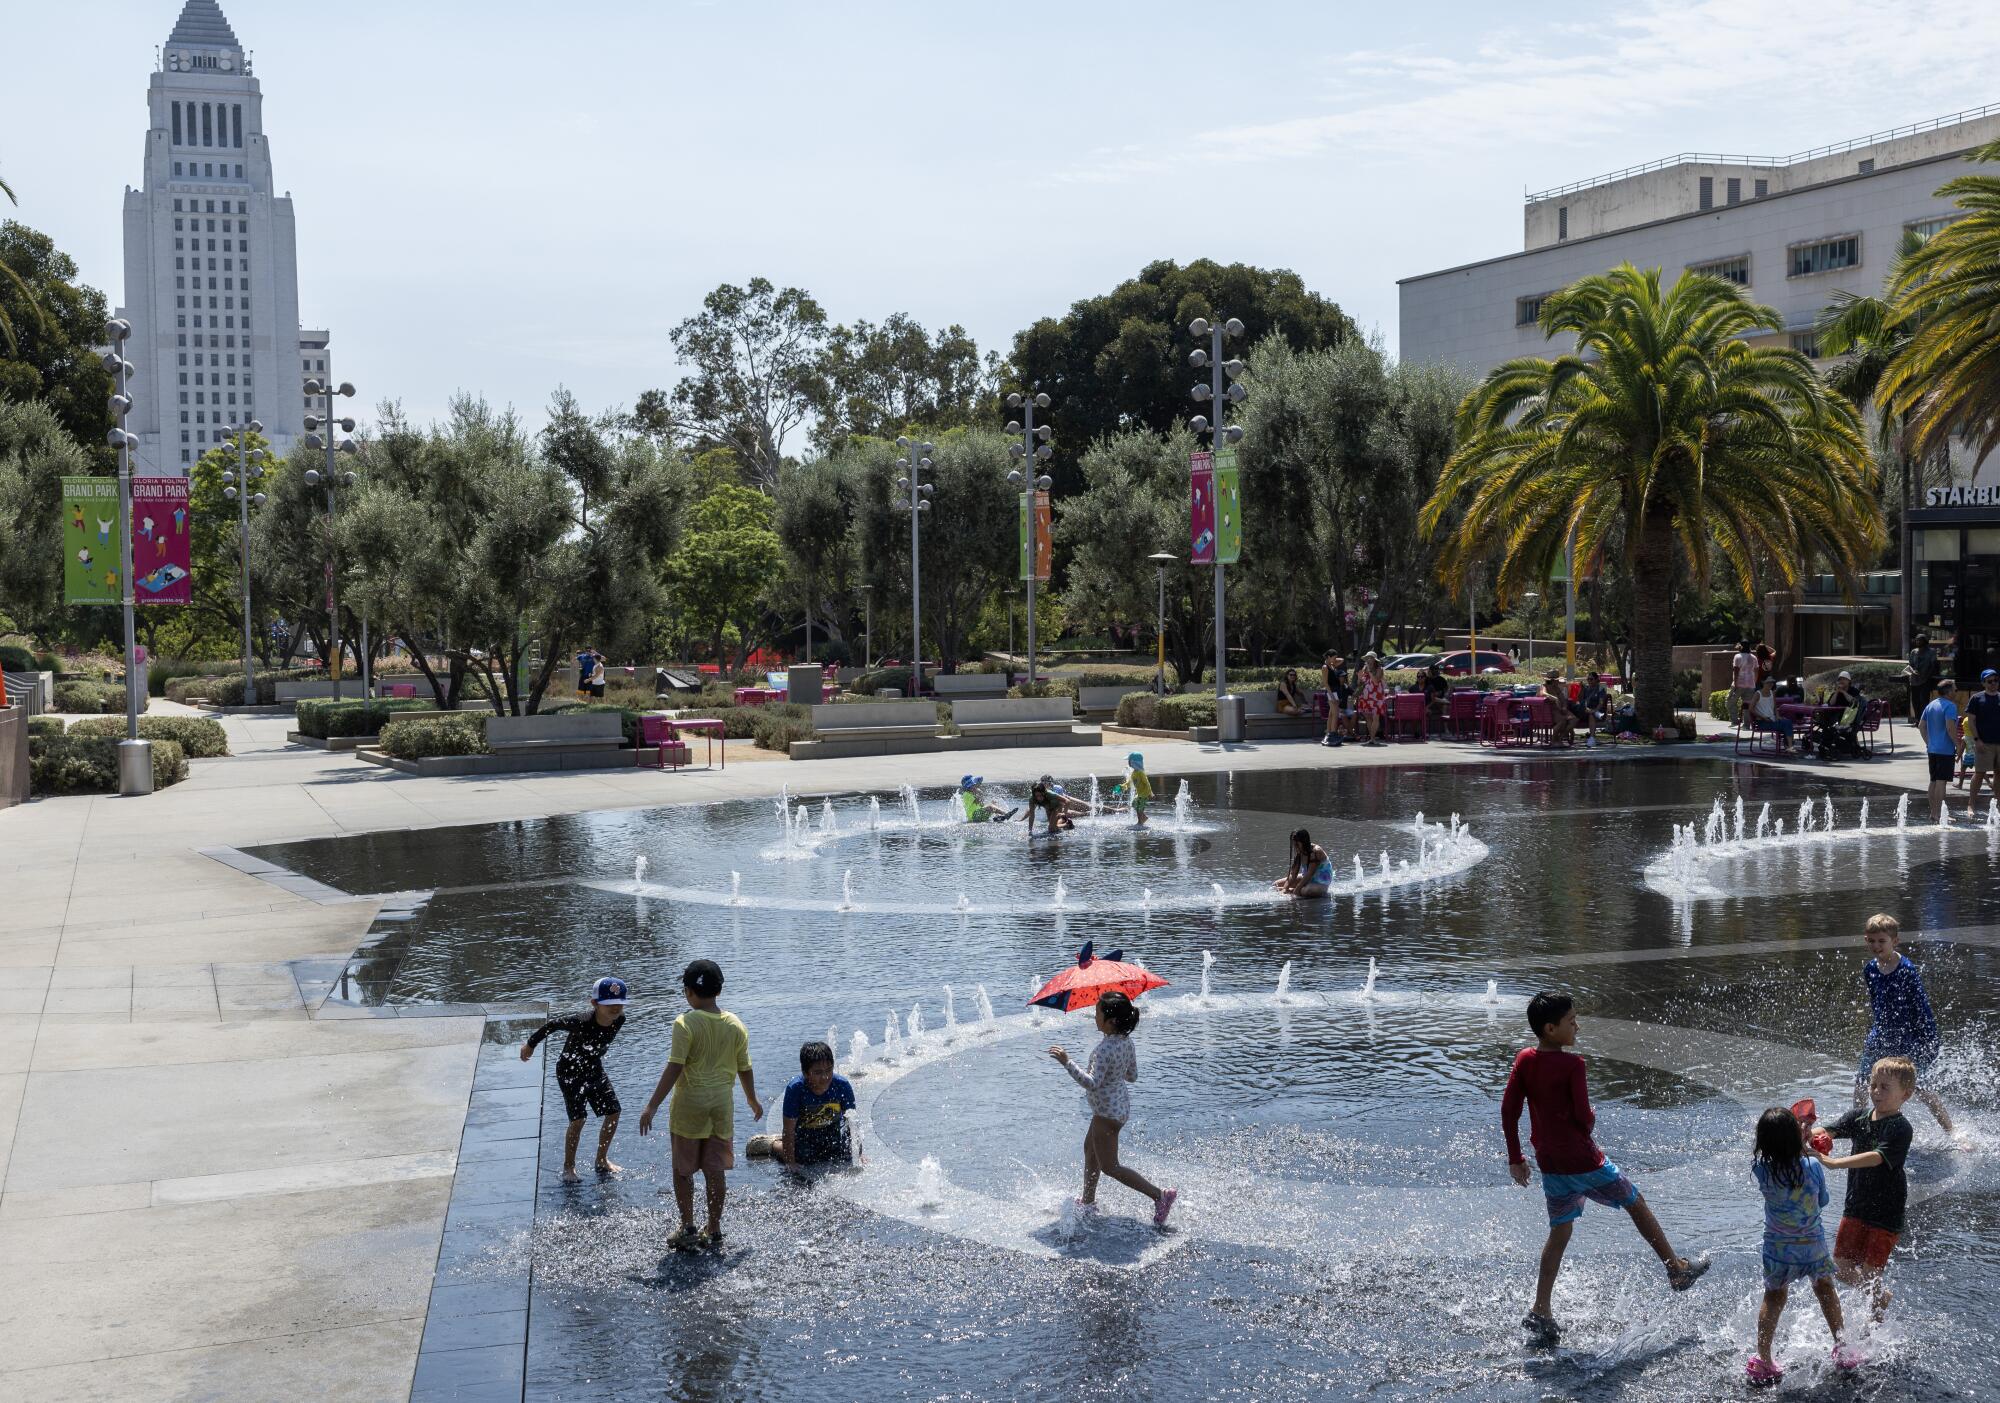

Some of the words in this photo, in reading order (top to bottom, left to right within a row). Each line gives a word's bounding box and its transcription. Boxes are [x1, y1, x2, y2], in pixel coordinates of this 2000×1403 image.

[63, 484, 93, 497] GRAND
[95, 484, 118, 497] PARK
[133, 484, 163, 497] GRAND
[165, 484, 188, 497] PARK
